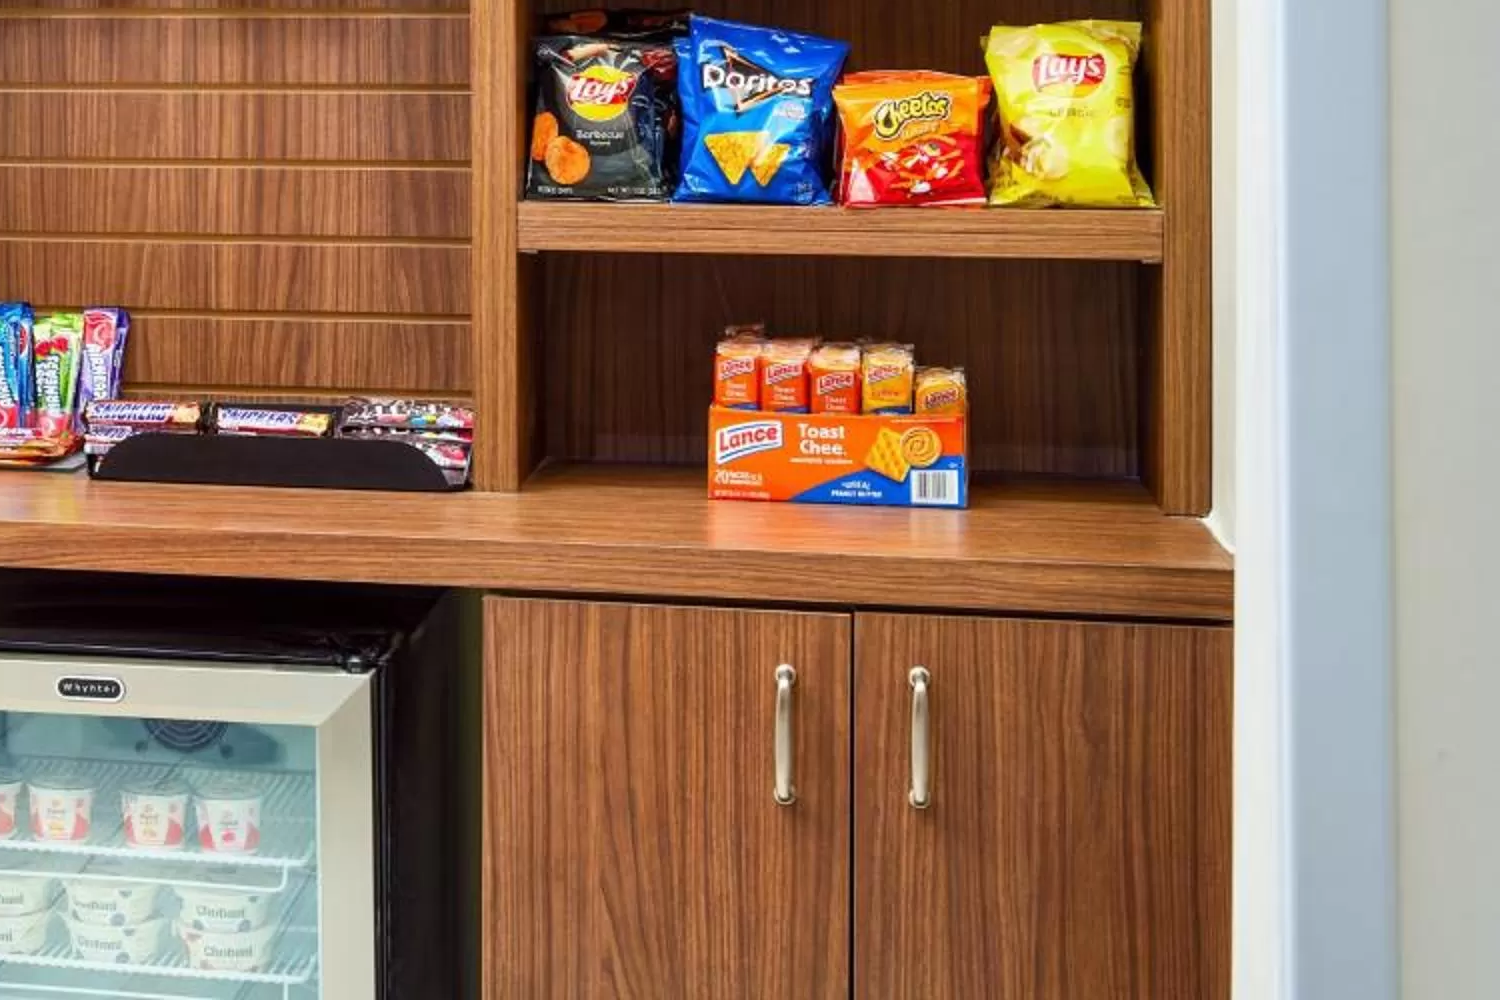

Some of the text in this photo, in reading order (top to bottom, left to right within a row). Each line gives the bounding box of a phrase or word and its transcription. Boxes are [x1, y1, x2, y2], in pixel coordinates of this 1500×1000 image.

[703, 64, 813, 96] Doritos
[1037, 52, 1105, 90] Lay's
[569, 75, 633, 105] Lay's
[876, 92, 951, 140] Cheetos
[719, 424, 779, 453] Lance
[799, 424, 845, 440] Toast
